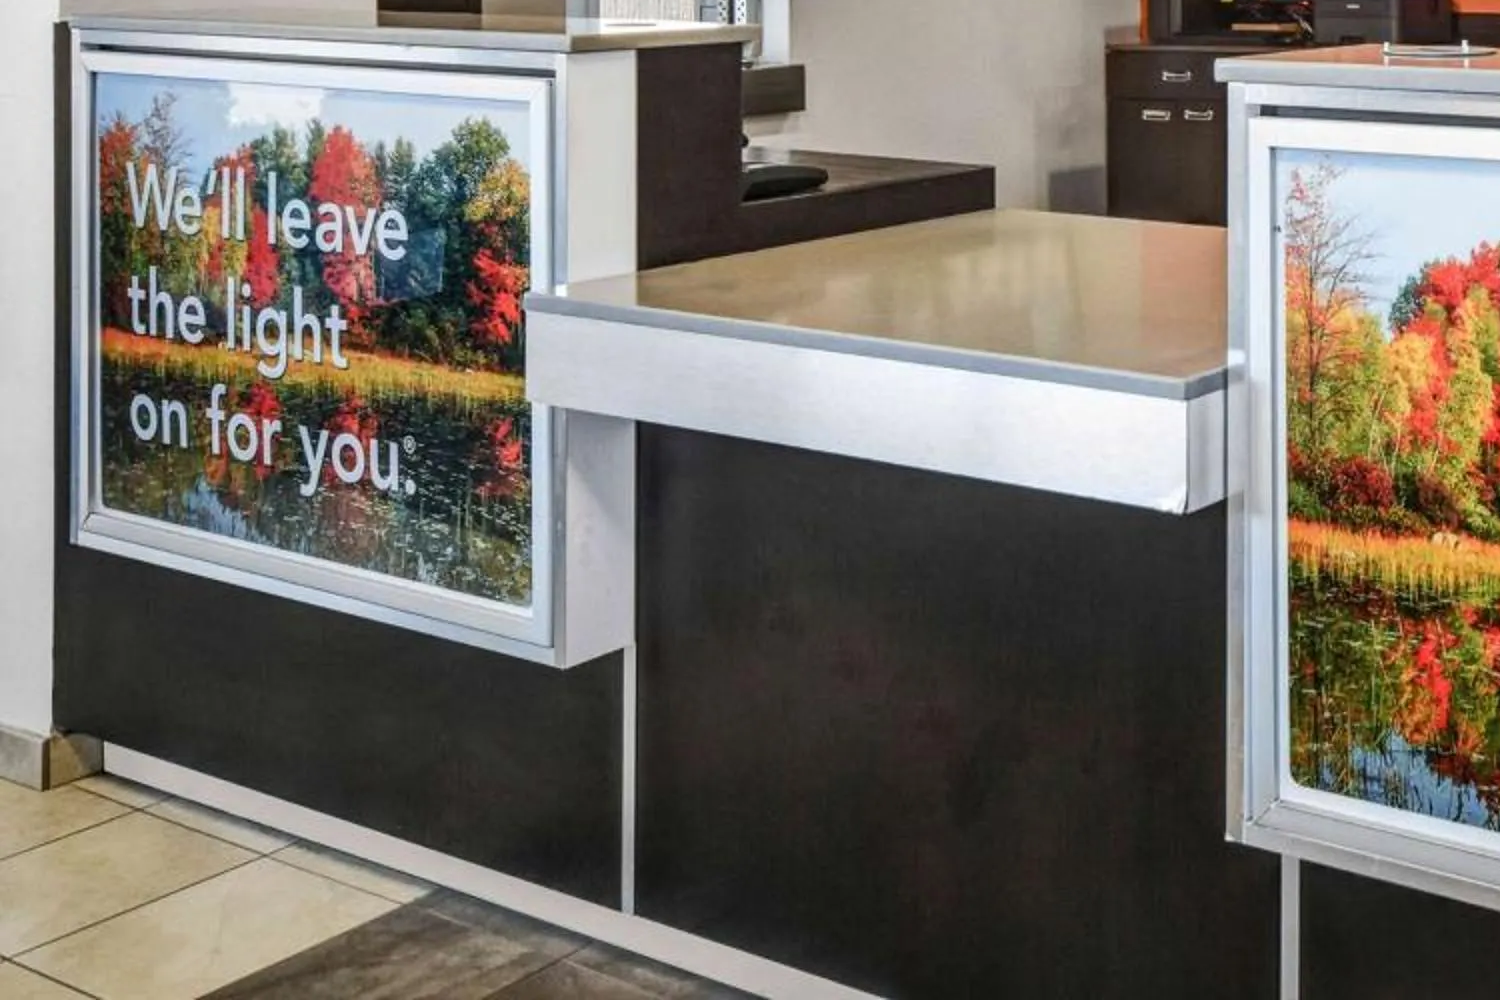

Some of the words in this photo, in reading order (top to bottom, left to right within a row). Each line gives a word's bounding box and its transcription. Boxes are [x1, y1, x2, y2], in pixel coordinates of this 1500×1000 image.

[126, 161, 245, 241] We'll
[267, 172, 409, 261] leave
[126, 265, 207, 345] the
[226, 276, 349, 379] light
[129, 390, 189, 449] on
[205, 383, 283, 466] for
